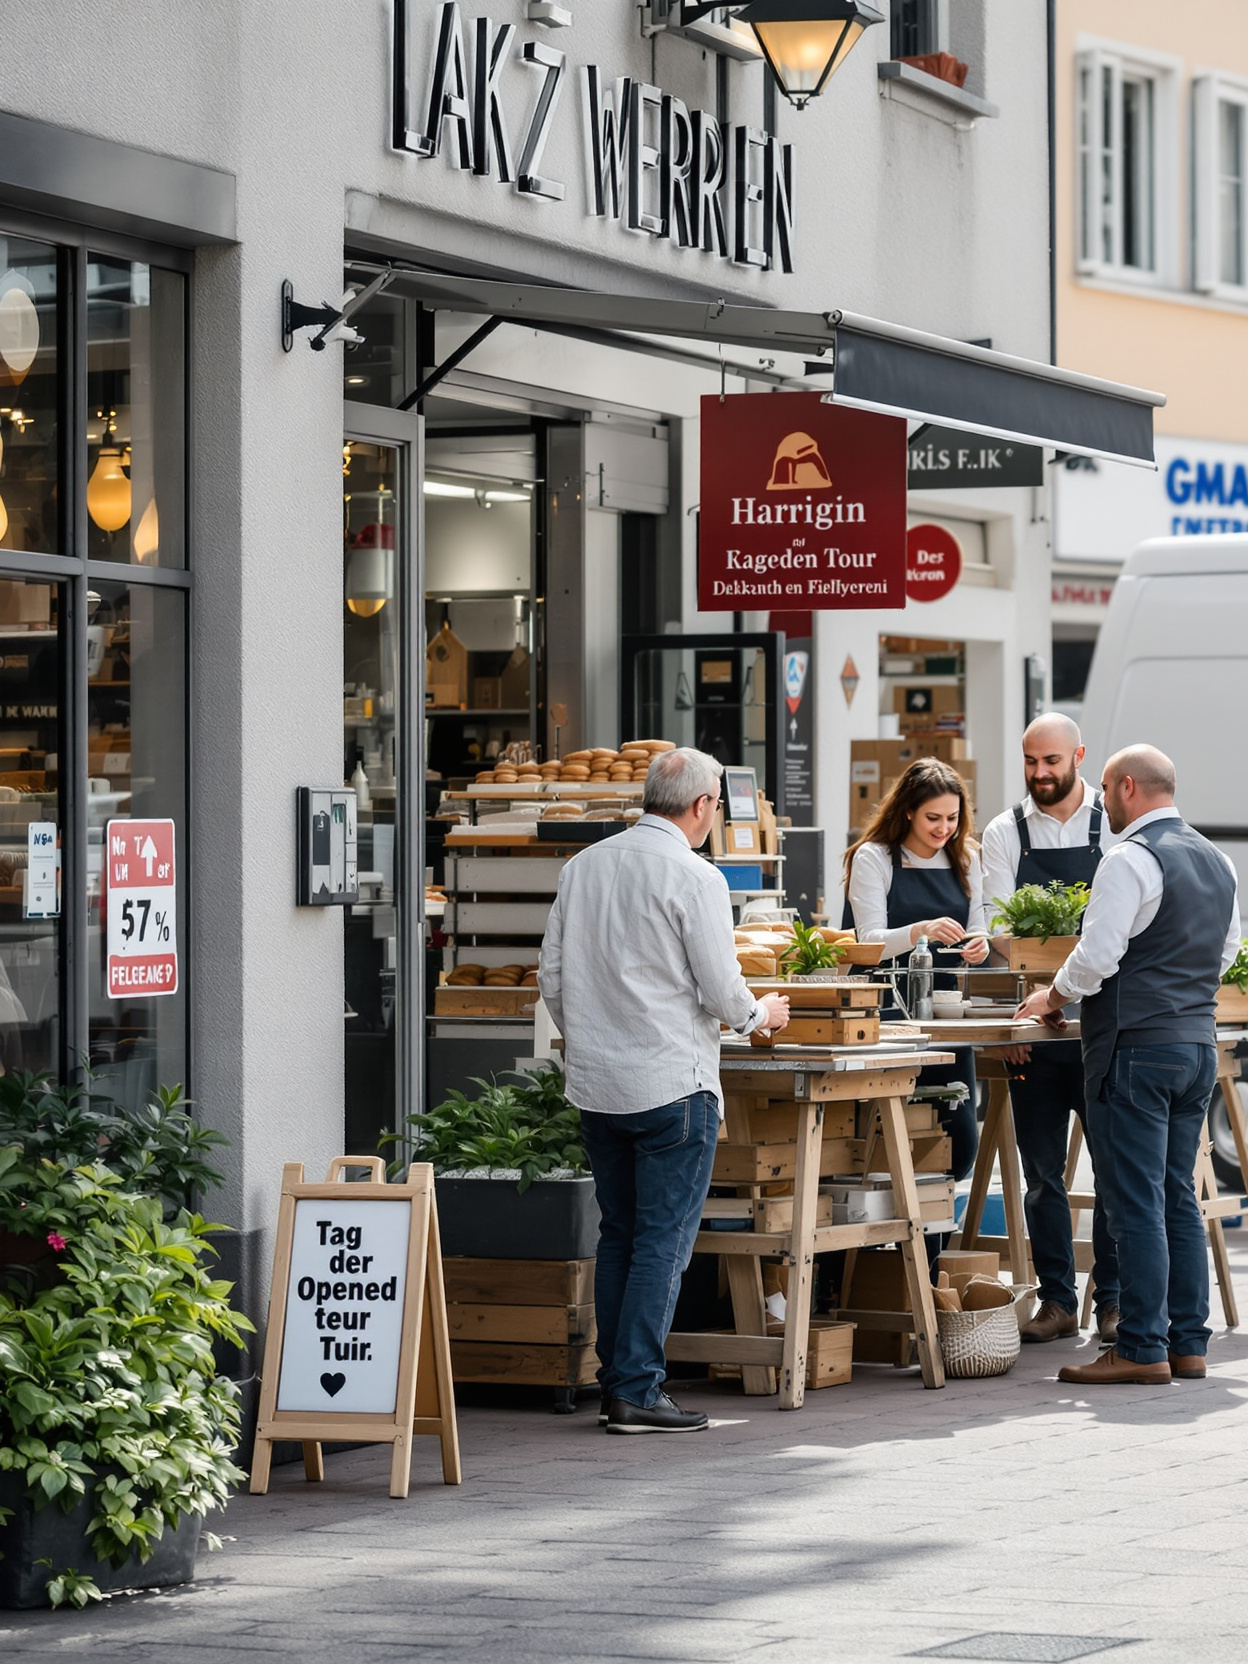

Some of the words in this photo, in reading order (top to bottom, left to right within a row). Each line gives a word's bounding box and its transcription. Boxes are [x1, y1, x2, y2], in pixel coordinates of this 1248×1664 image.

[580, 64, 796, 273] WERREN
[731, 495, 867, 530] Harrigin
[824, 548, 877, 568] Tour
[785, 584, 803, 594] en
[316, 1220, 362, 1251] Tag
[329, 1249, 374, 1274] der
[297, 1276, 398, 1306] Opened
[314, 1307, 371, 1331] teur
[319, 1336, 373, 1362] Tuir.
